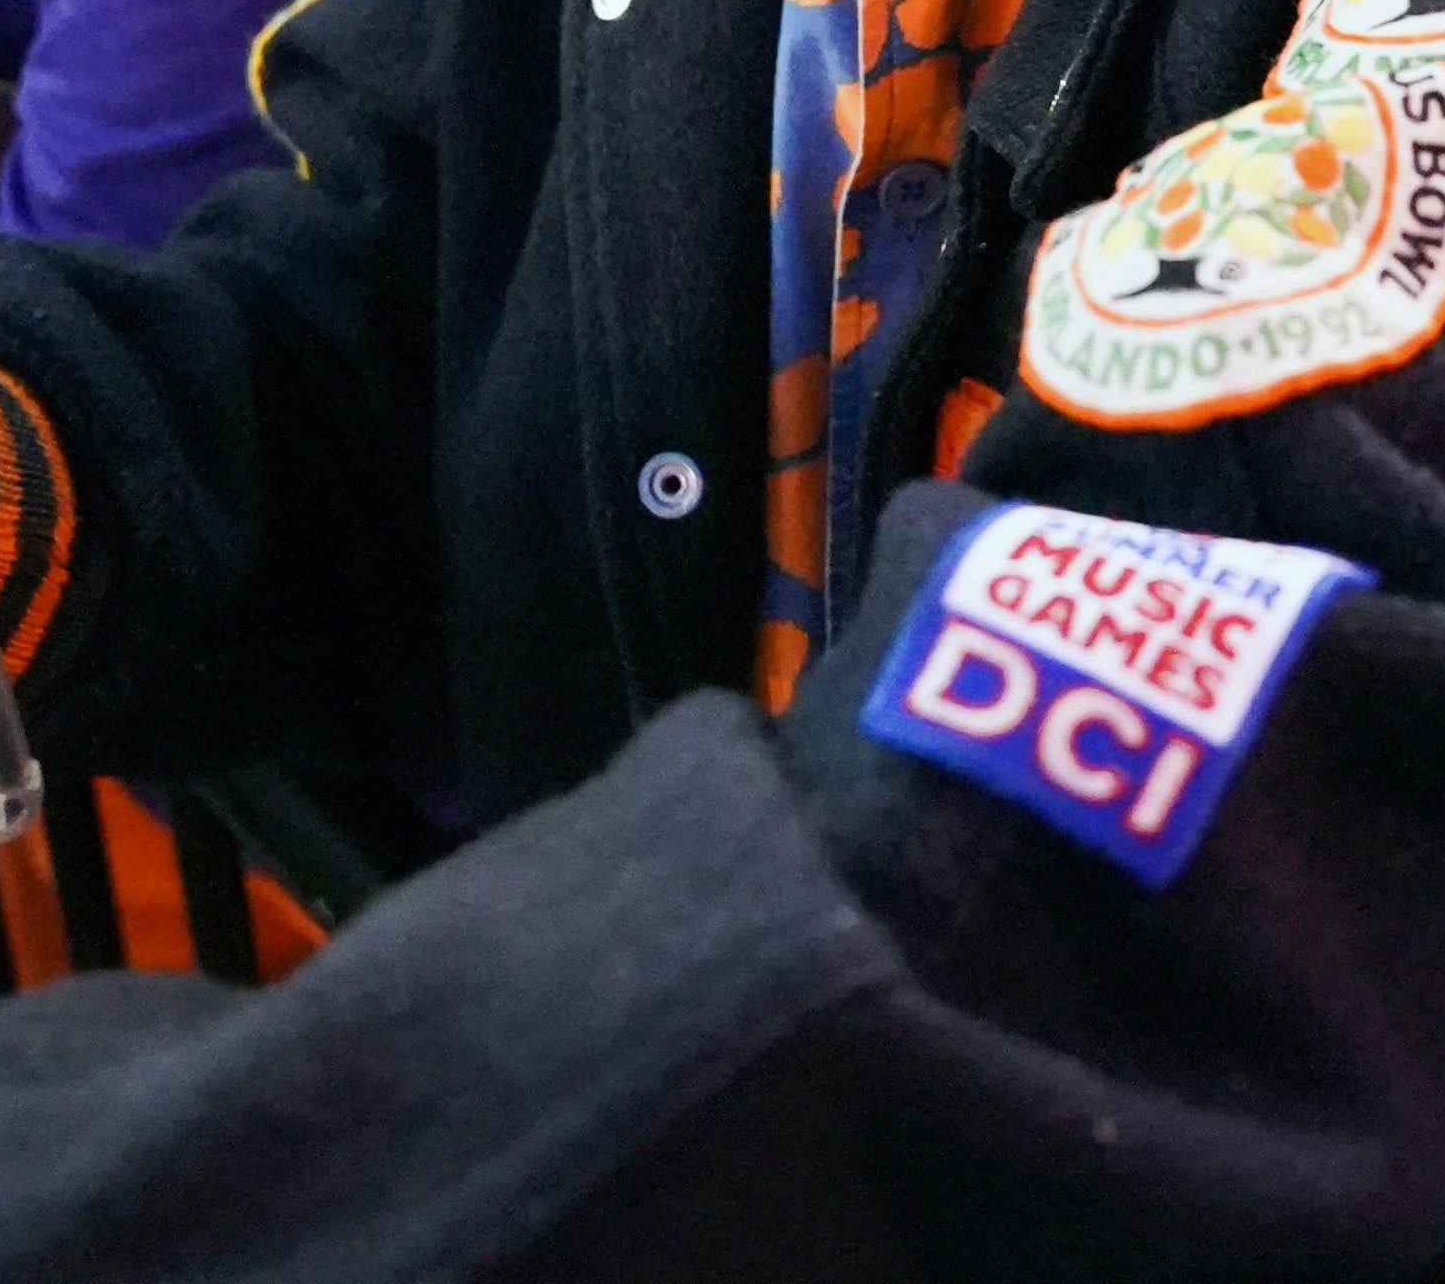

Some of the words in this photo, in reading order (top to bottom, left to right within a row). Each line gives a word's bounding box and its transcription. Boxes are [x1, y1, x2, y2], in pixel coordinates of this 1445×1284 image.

[986, 573, 1228, 713] GAMES
[1008, 532, 1256, 662] MUSIC
[905, 617, 1205, 841] DCI
